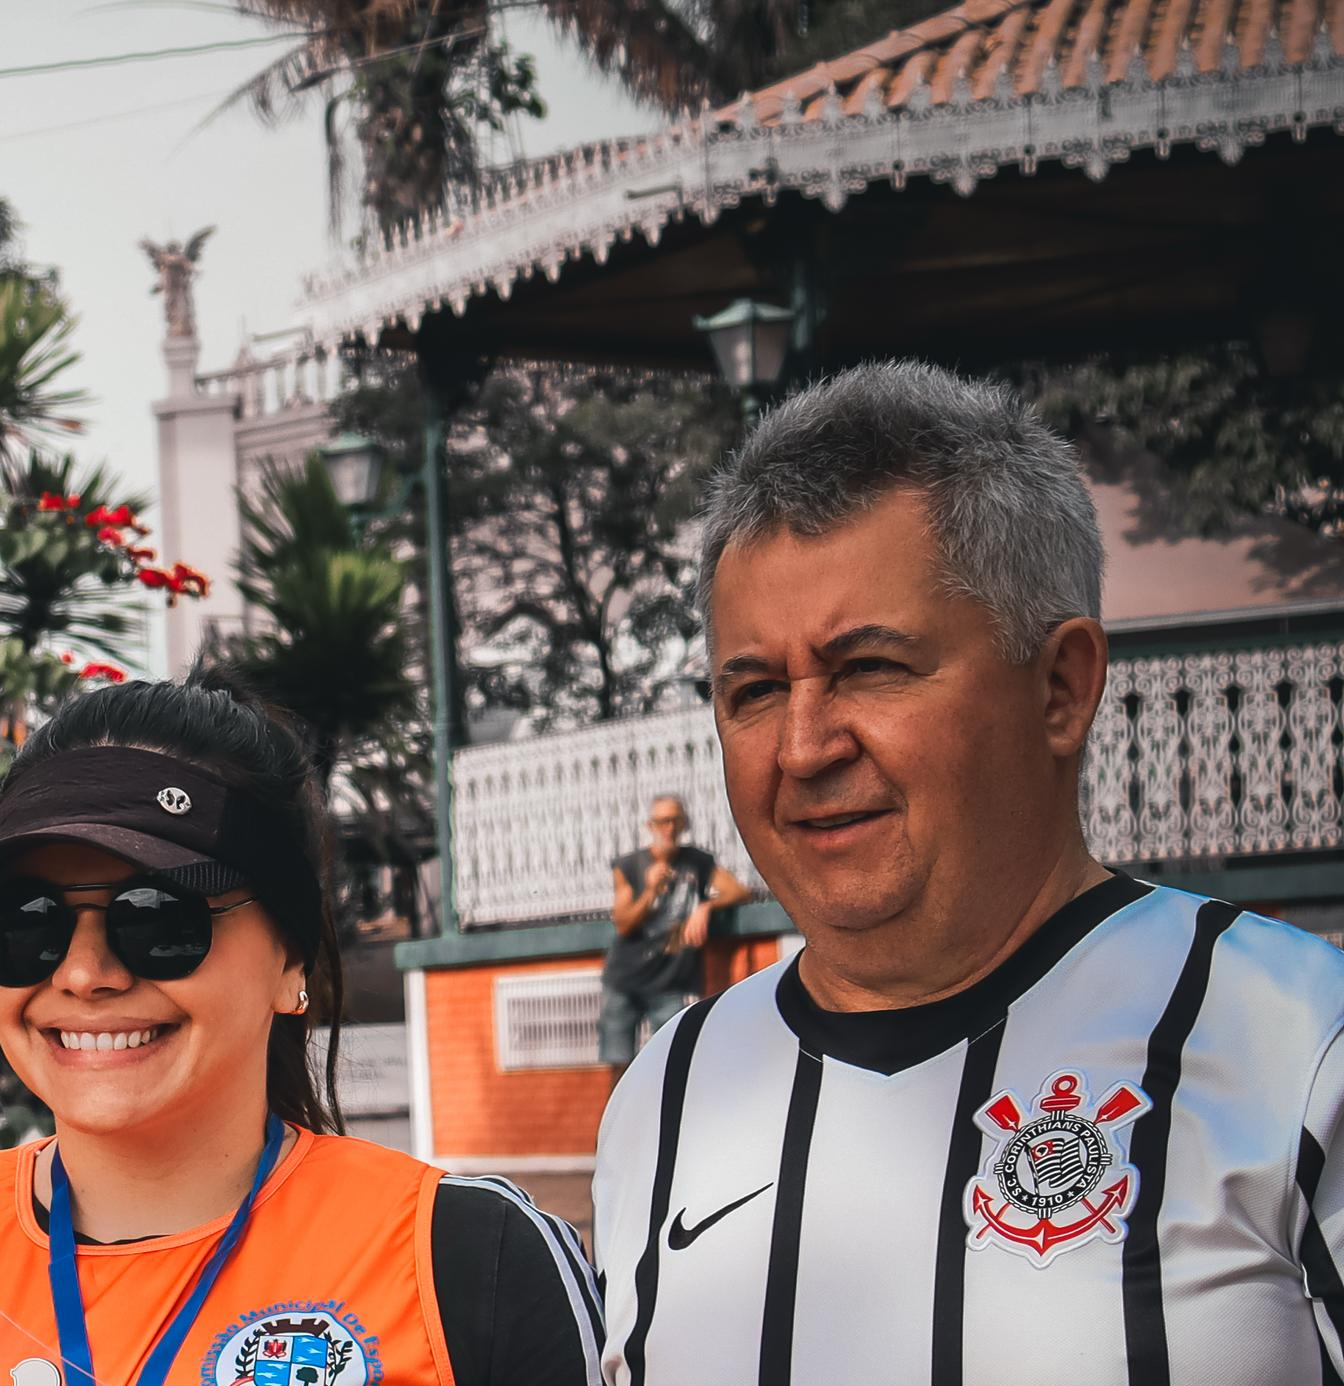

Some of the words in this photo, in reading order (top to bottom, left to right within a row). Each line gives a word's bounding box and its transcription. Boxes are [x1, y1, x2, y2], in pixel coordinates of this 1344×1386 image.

[1005, 1121, 1082, 1173] CORINTHIANS
[1076, 1130, 1099, 1189] PAULISTA
[1031, 1194, 1063, 1207] 1910
